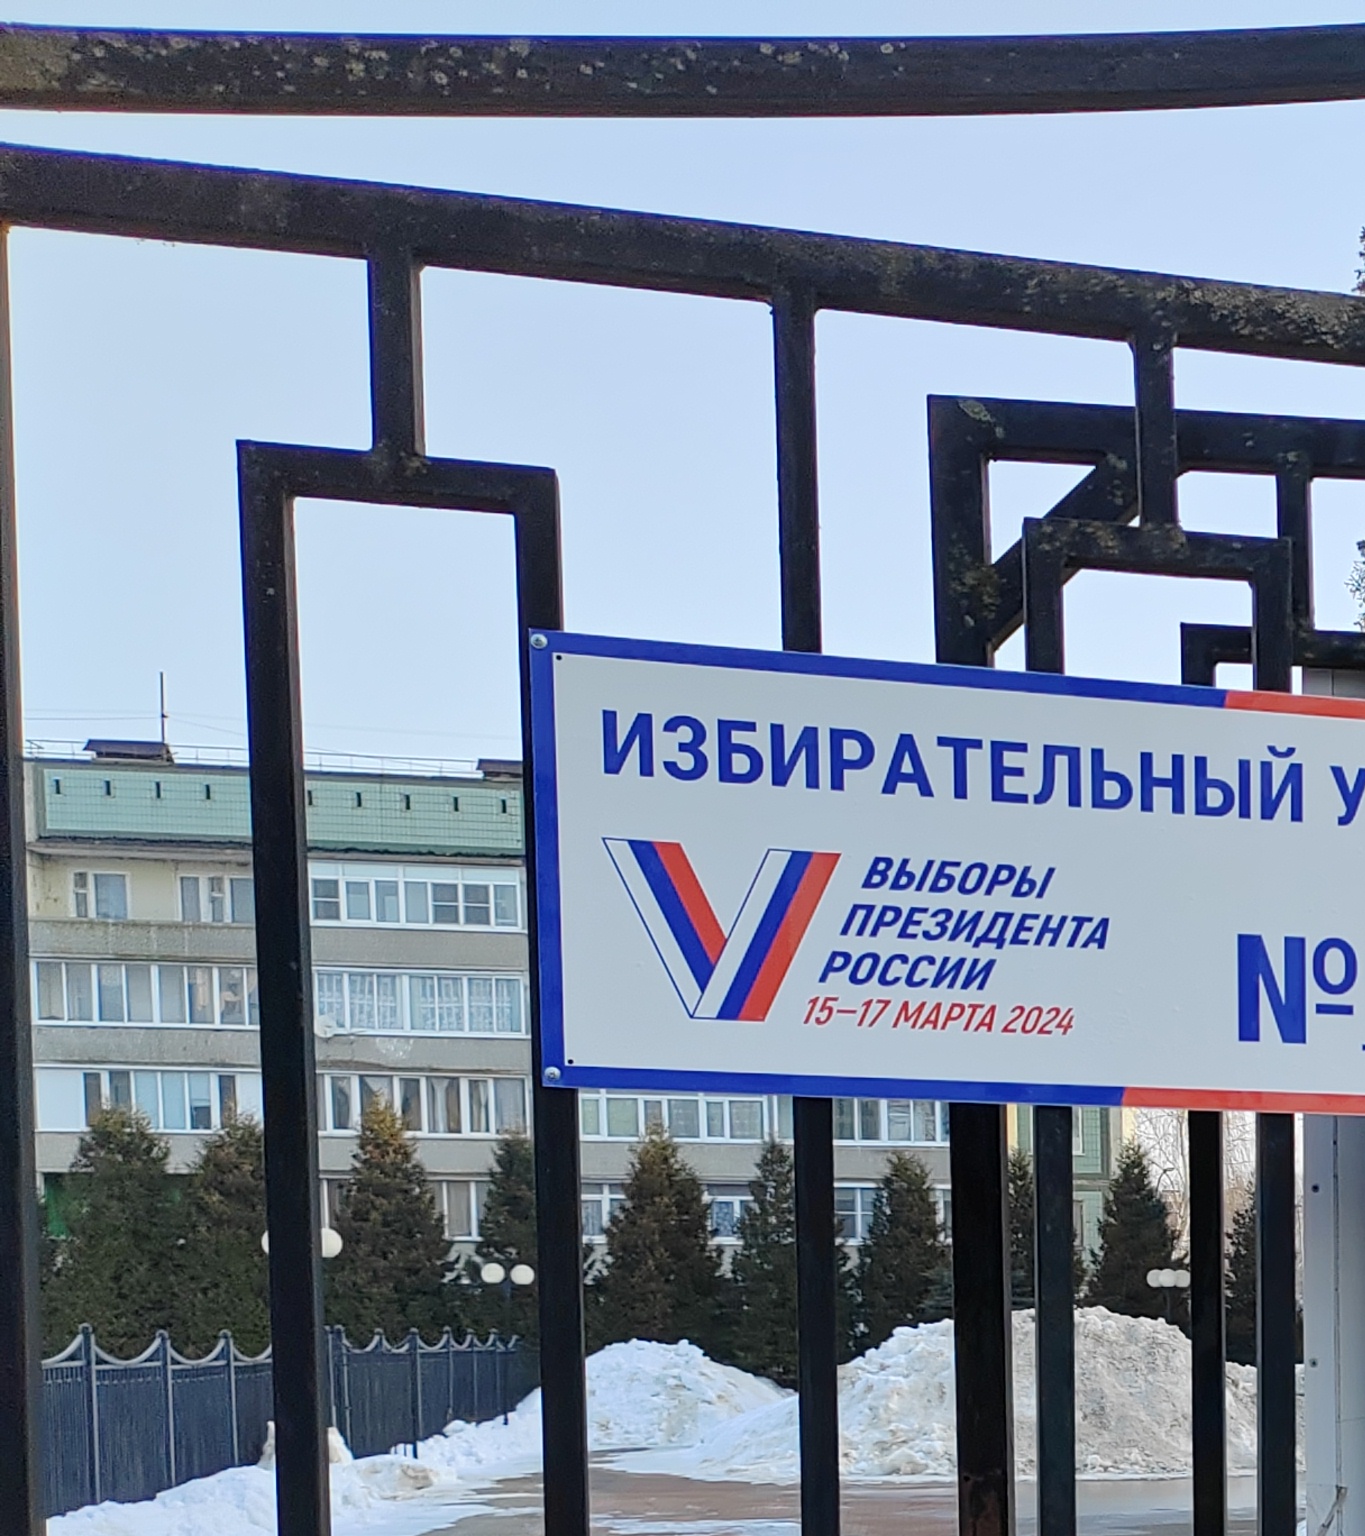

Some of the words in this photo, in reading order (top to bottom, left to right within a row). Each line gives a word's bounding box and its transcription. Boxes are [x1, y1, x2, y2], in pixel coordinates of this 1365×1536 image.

[601, 708, 1304, 823] ИЗБИРАТЕЛЬНЫЙ
[860, 855, 1057, 899] ВЫБОРЫ
[839, 903, 1111, 950] ПРЕЗИДЕНТА
[818, 950, 998, 991] РОССИИ
[891, 999, 998, 1033] МАРТА
[1000, 1004, 1076, 1036] 2024
